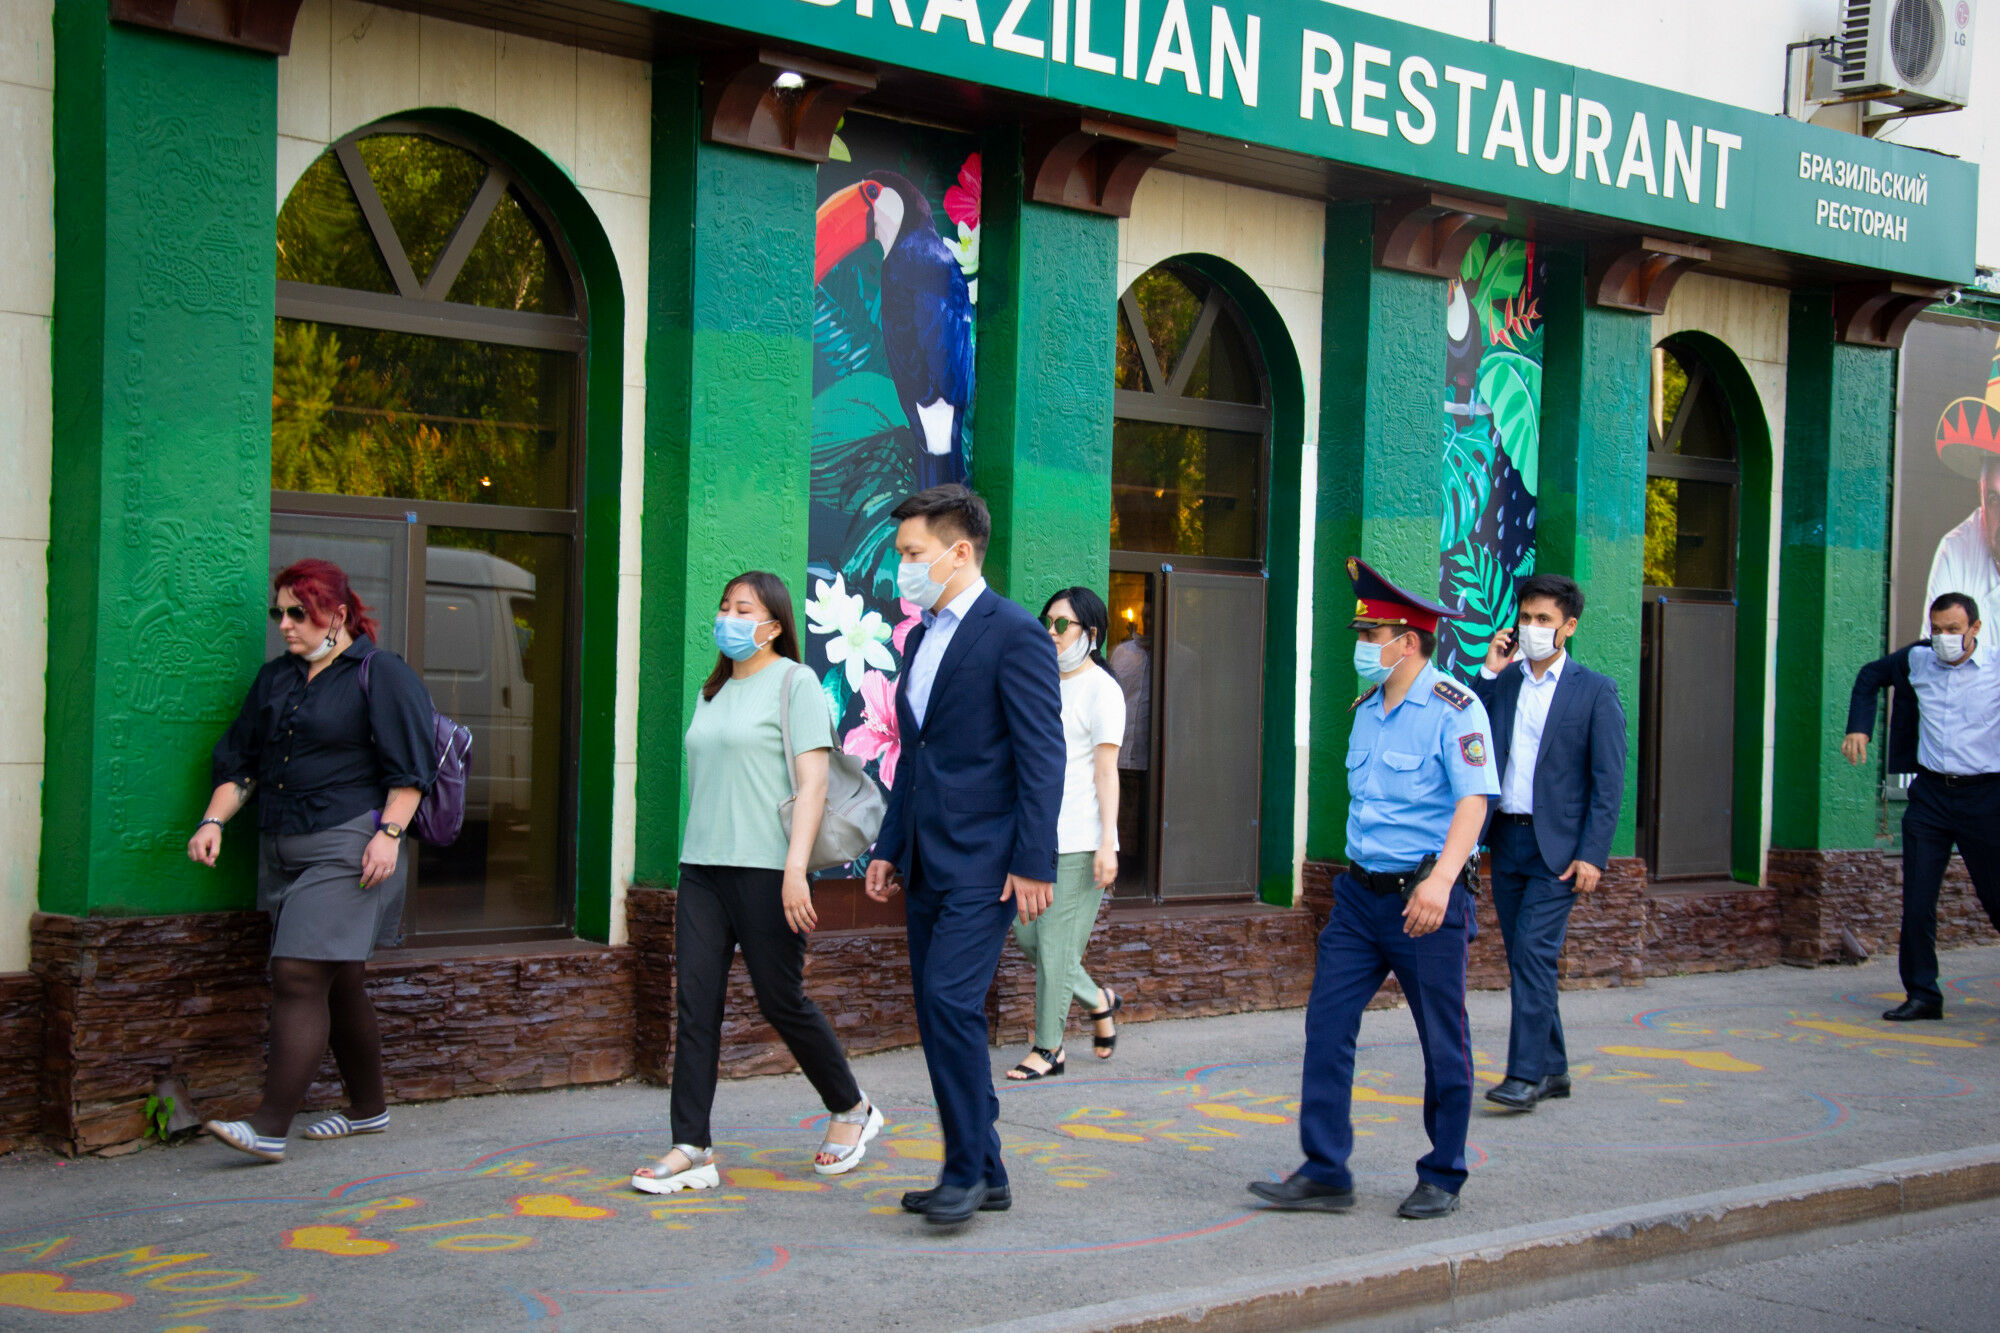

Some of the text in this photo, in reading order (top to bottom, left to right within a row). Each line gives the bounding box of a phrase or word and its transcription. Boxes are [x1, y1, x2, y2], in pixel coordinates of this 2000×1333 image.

[1954, 31, 1966, 46] LG
[796, 0, 1741, 209] ZILIAN RESTAURANT
[1799, 151, 1929, 206] БРАЗИЛЬСКИЙ
[1816, 198, 1908, 242] РЕСТОРАН
